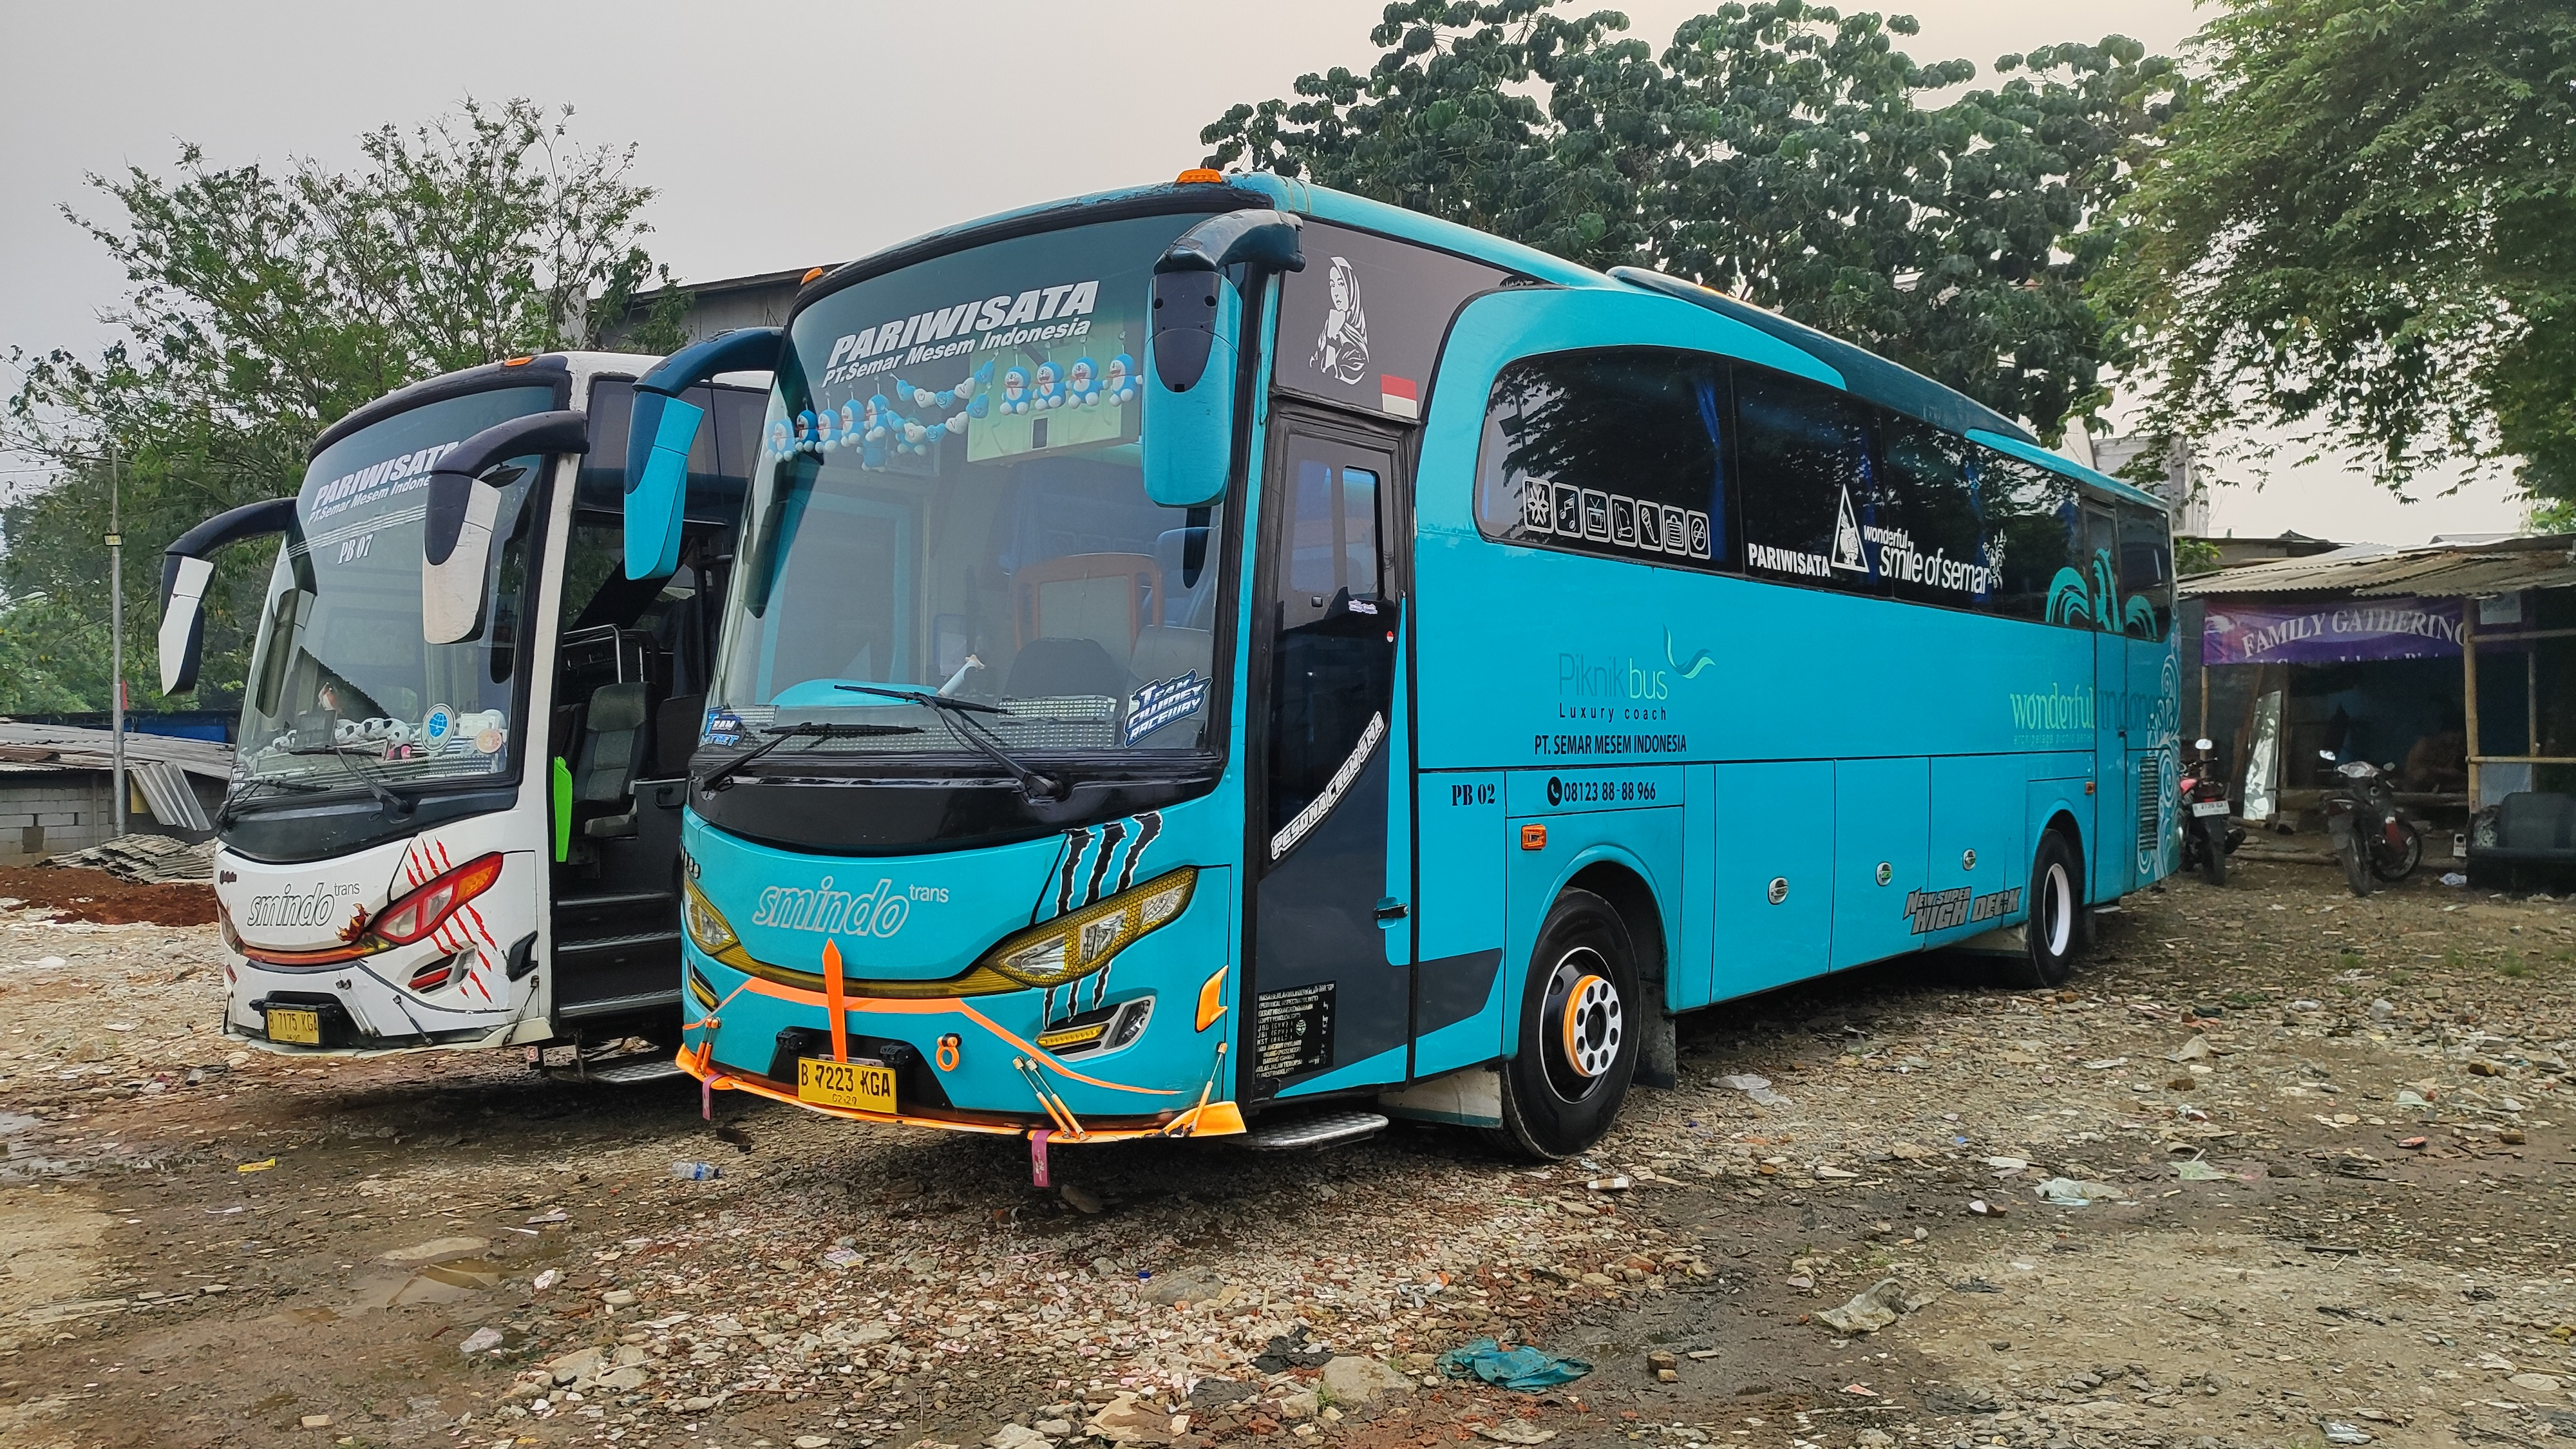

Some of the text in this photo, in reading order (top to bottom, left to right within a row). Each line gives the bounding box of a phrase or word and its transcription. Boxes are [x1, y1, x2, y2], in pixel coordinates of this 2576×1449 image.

[826, 280, 1099, 368] PARIWISATA
[905, 341, 974, 366] Mesem
[980, 317, 1091, 349] Indonesia
[351, 486, 389, 509] Mesem
[391, 475, 431, 495] Indone
[338, 534, 374, 565] PB 07
[1864, 525, 1909, 549] wonderful
[1748, 542, 1831, 577] PARIWISATA
[1879, 541, 1990, 594] smile of semar
[2241, 612, 2325, 658] FAMILY
[1129, 697, 1201, 742] RACEWAY
[1559, 702, 1666, 723] Luxury coach
[1535, 734, 1687, 755] PT. SEMAR MESEM INDONESIA
[1271, 712, 1383, 857] PESONA CREW SMA
[1451, 783, 1496, 806] PB 02
[1564, 782, 1598, 802] 08123
[1637, 781, 1656, 800] 966
[247, 882, 360, 927] smindo trans
[752, 876, 950, 938] smindo trans
[1911, 886, 2022, 935] HIGH DECK
[269, 1012, 318, 1032] B 7175 KGA
[801, 1063, 891, 1097] B 7223 KGA
